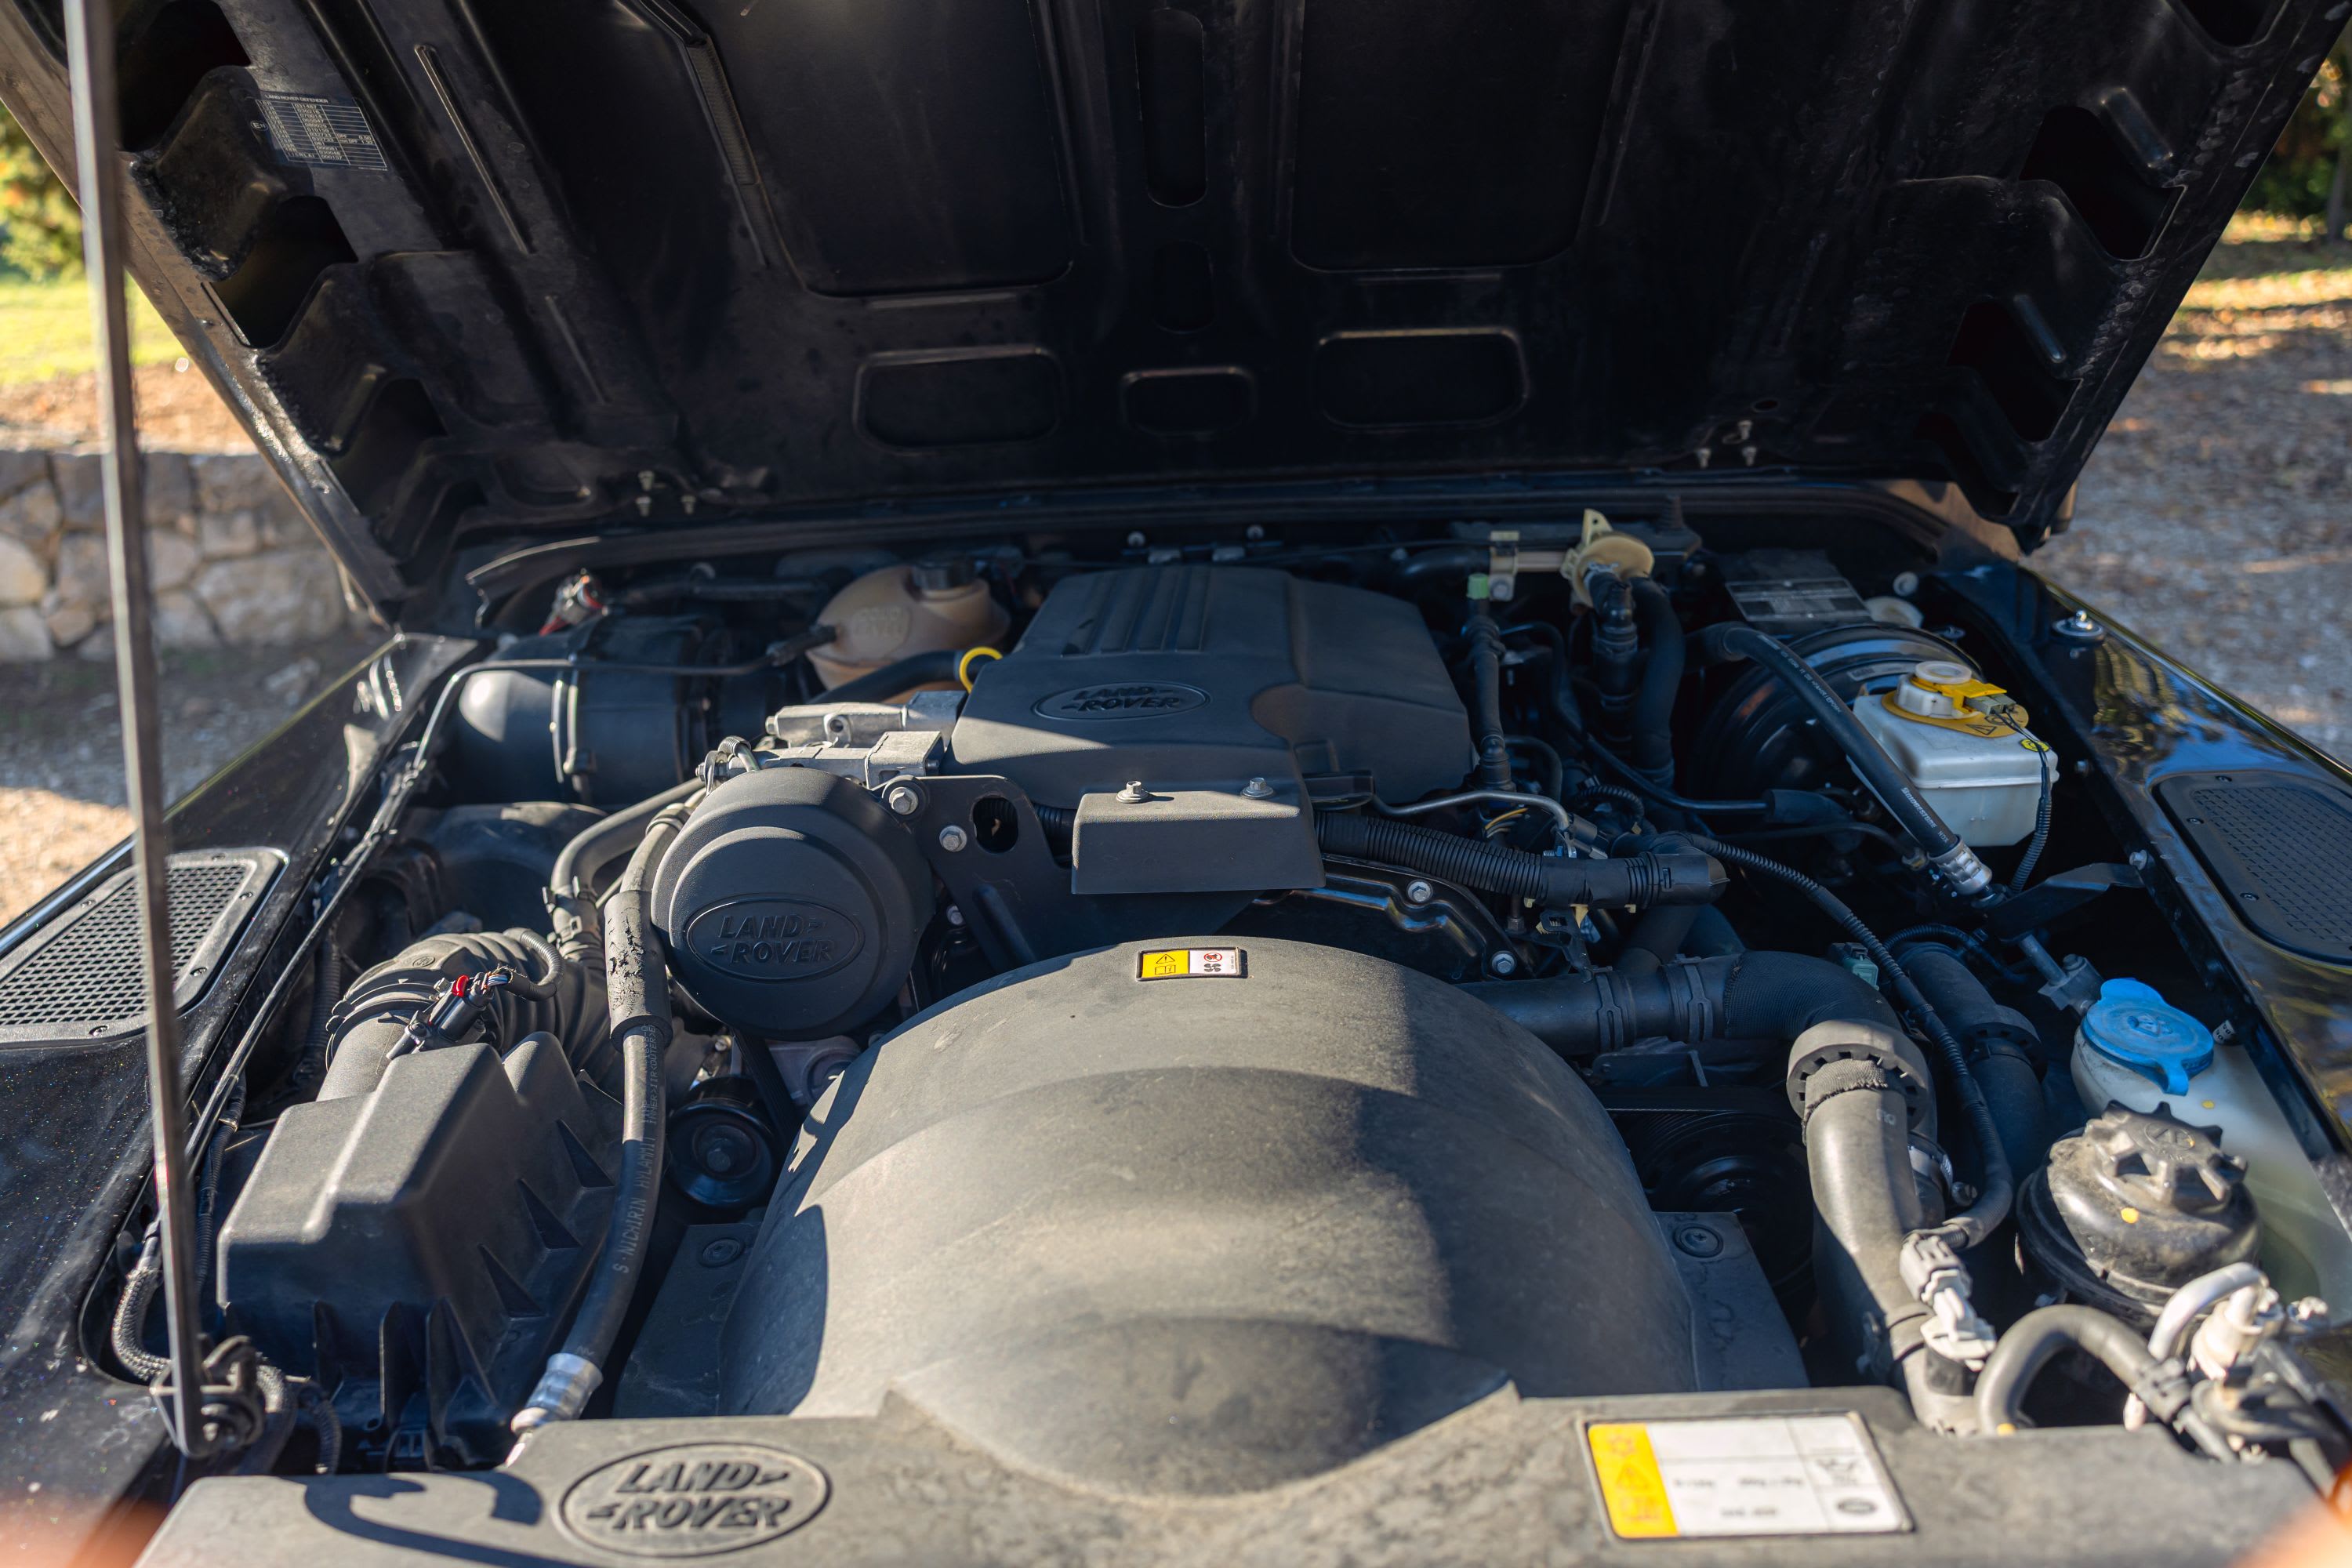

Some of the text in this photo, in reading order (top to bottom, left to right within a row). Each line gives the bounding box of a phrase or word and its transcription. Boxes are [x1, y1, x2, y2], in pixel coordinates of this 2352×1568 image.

[1073, 686, 1154, 700] LAND
[1077, 697, 1180, 711] ROVER
[718, 914, 807, 938] LAND
[730, 939, 835, 964] ROVER
[616, 1462, 760, 1494] LAND
[612, 1497, 792, 1530] ROVER
